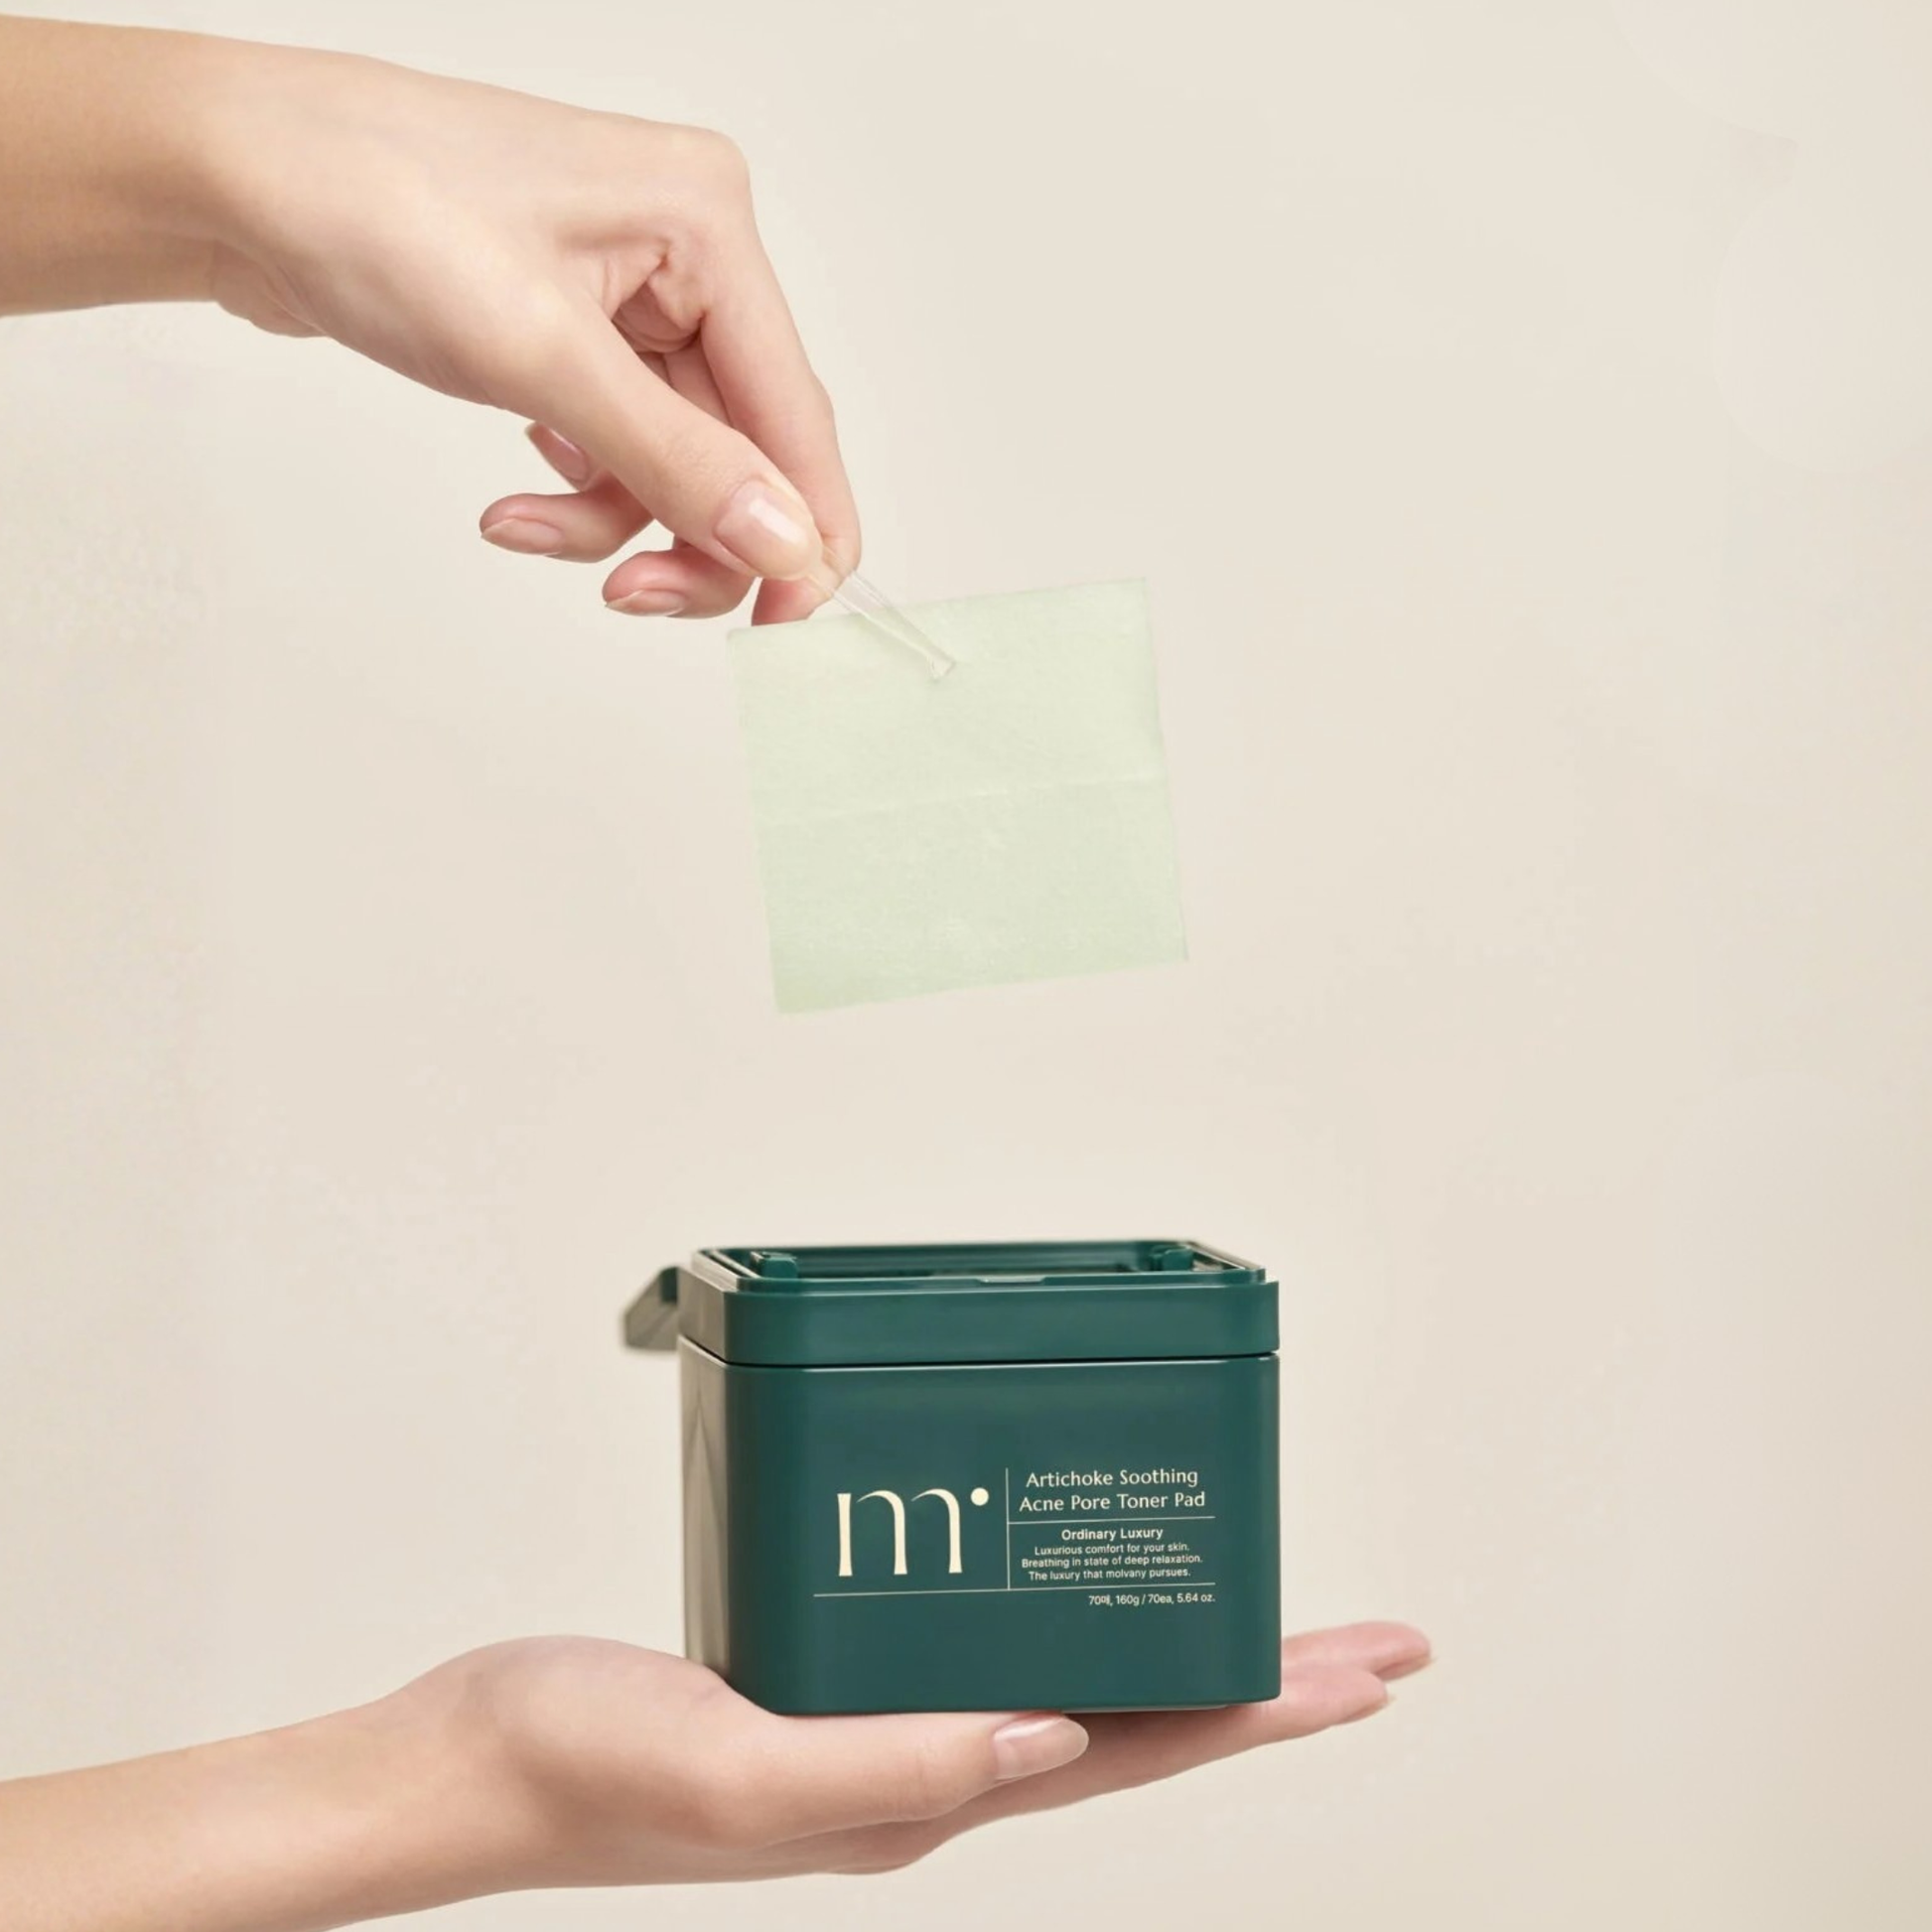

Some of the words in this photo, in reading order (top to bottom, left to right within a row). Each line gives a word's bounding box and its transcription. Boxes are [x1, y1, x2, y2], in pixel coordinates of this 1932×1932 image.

[1027, 1470, 1113, 1487] Artichoke
[1120, 1468, 1197, 1486] Soothing
[1020, 1497, 1063, 1512] Acne
[1071, 1495, 1110, 1510] Pore
[1117, 1493, 1168, 1508] Toner
[1175, 1491, 1205, 1507] Pad
[1061, 1529, 1116, 1542] Ordinary
[1121, 1528, 1163, 1540] Luxury
[1035, 1546, 1082, 1556] Luxurious
[1085, 1545, 1124, 1554] comfort
[1127, 1544, 1140, 1553] for
[1144, 1544, 1165, 1554] your
[1168, 1543, 1189, 1552] skin.
[1022, 1558, 1069, 1569] Breathing
[1072, 1558, 1081, 1567] in
[1084, 1558, 1109, 1567] state
[1125, 1556, 1149, 1567] deep
[1153, 1554, 1203, 1565] relaxation.
[1029, 1571, 1047, 1581] The
[1050, 1570, 1080, 1581] luxury
[1083, 1570, 1103, 1579] that
[1106, 1570, 1146, 1580] molvany
[1150, 1569, 1190, 1579] pursues.
[1116, 1594, 1139, 1606] 160g
[1142, 1594, 1146, 1605] /
[1149, 1594, 1173, 1604] 70ea,
[1177, 1593, 1197, 1603] 5.64
